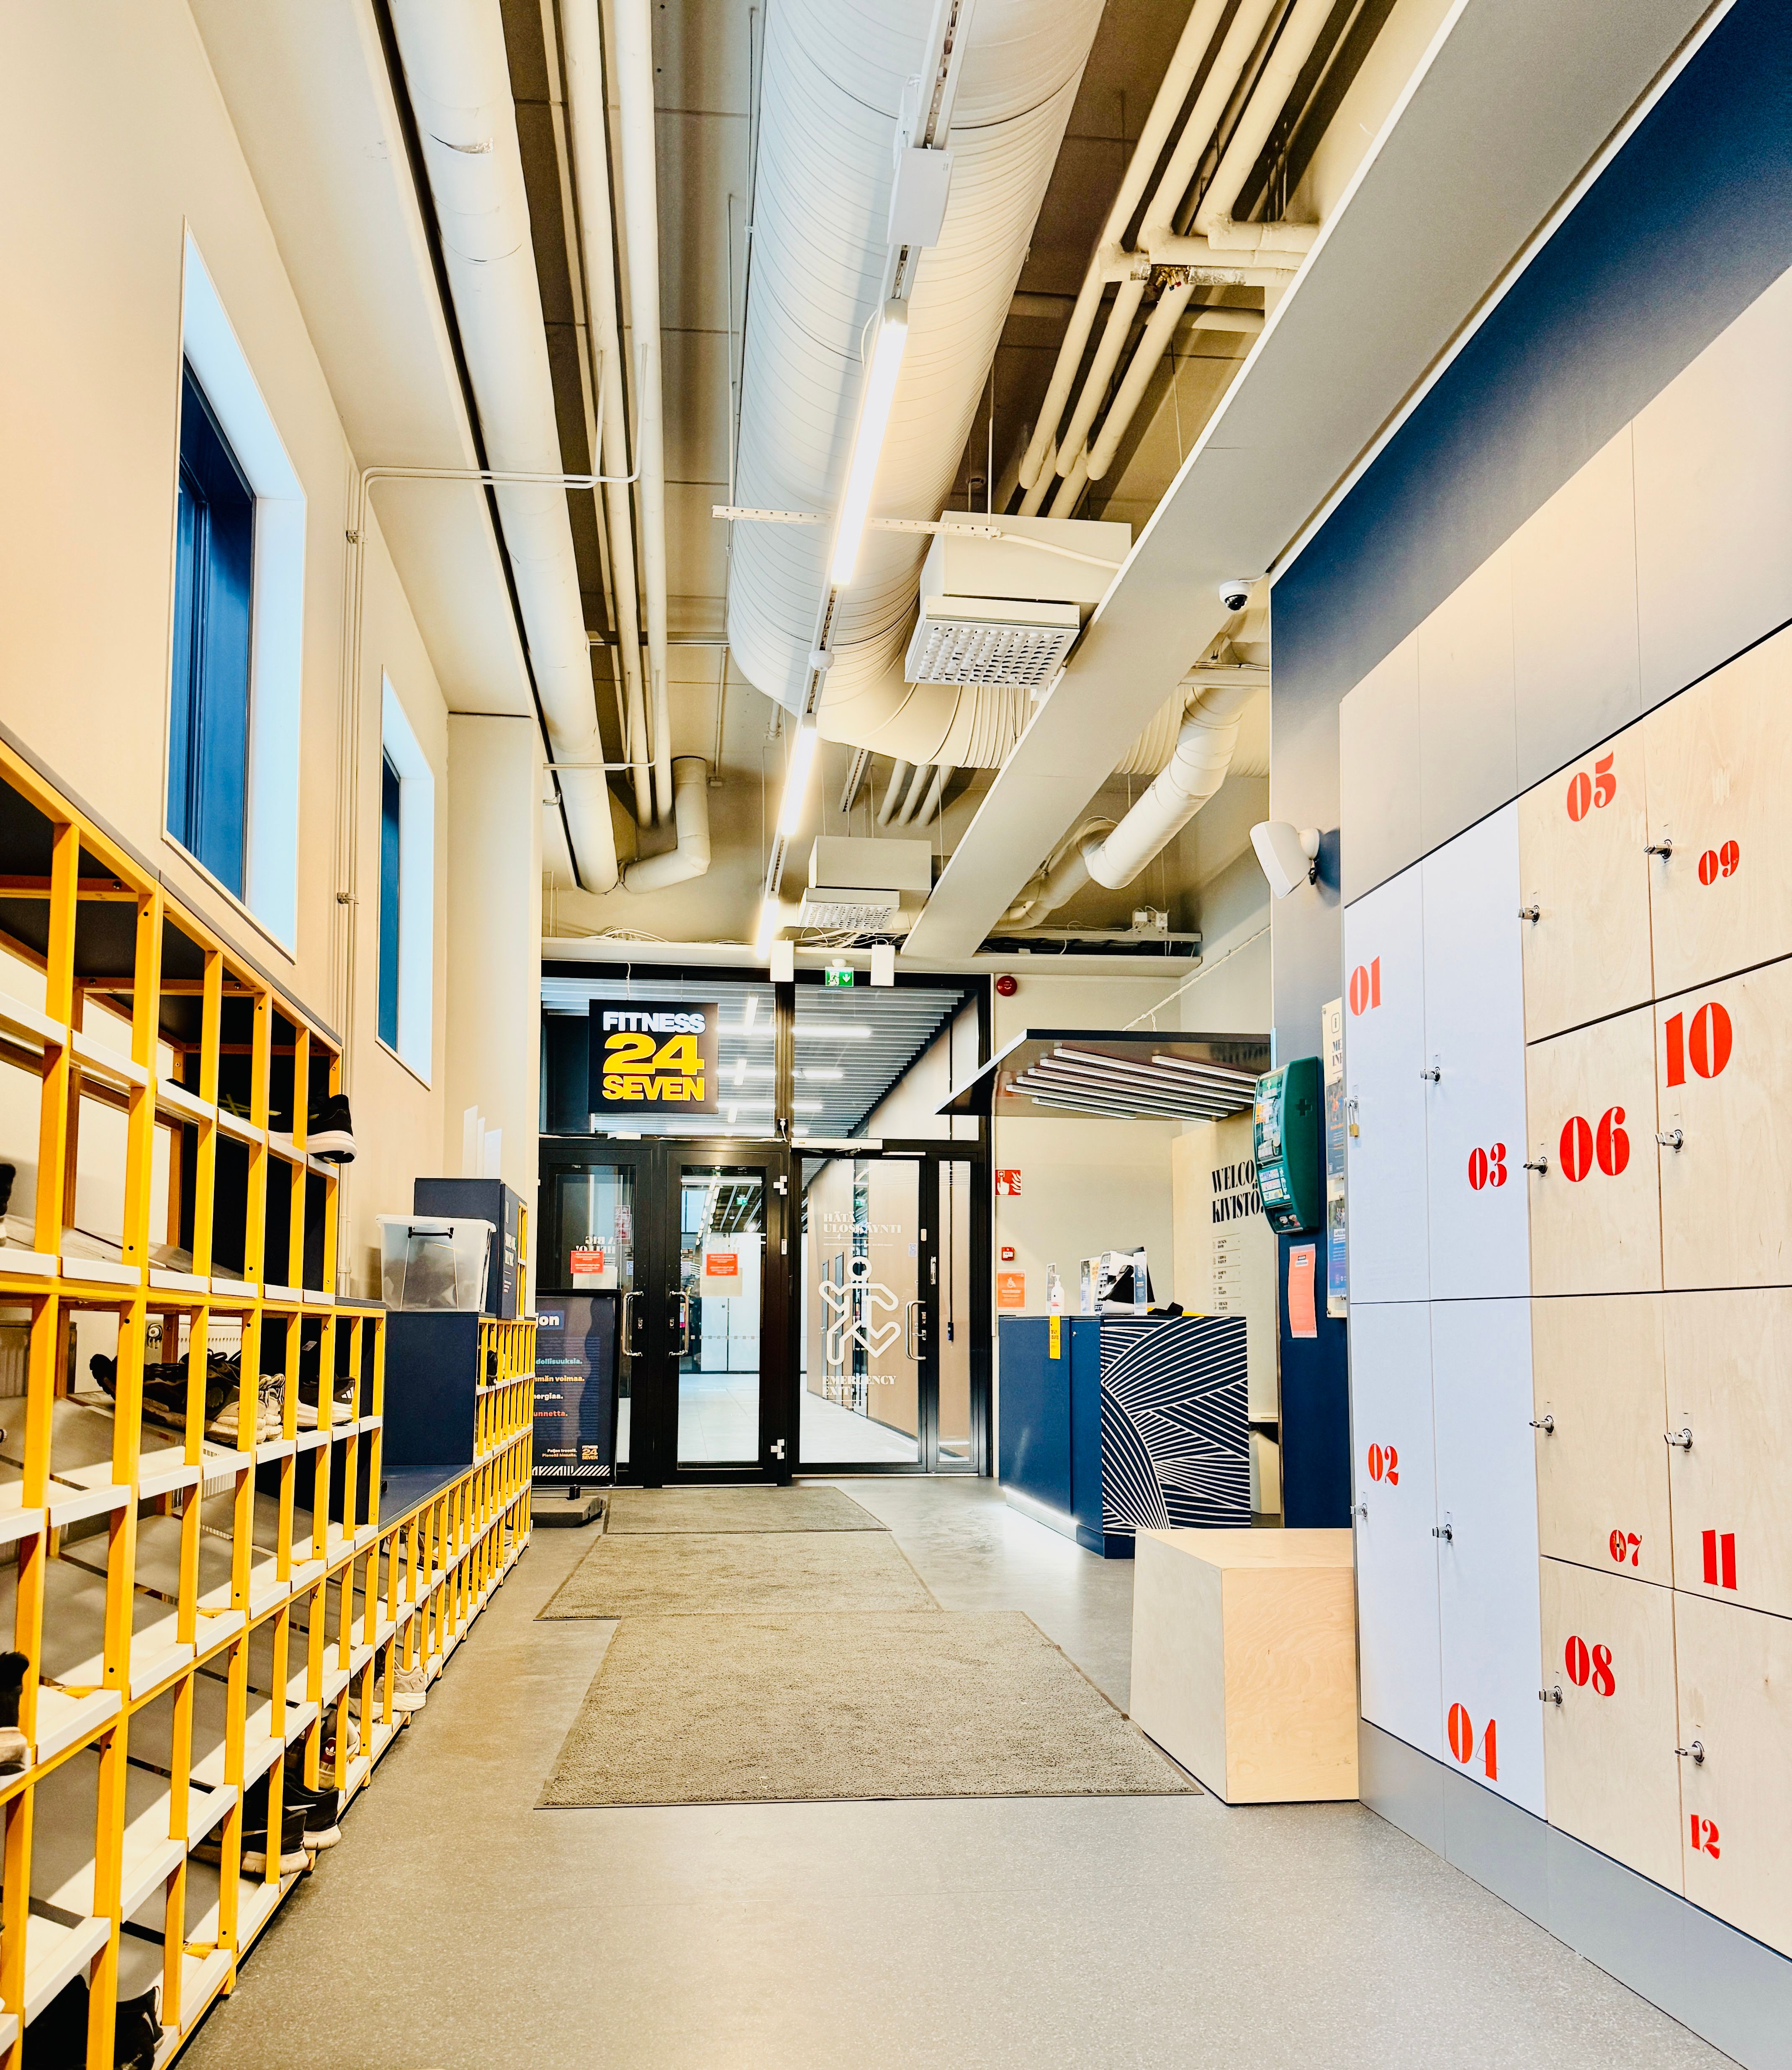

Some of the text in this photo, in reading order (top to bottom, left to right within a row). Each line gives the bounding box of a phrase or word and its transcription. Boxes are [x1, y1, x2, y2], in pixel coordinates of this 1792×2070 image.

[1567, 752, 1616, 822] 05
[1698, 840, 1740, 886] 09
[1350, 957, 1381, 1016] 01
[603, 1011, 706, 1034] FITNESS
[1665, 1002, 1733, 1088] 10
[603, 1032, 705, 1075] 24
[602, 1075, 705, 1101] SEVEN
[1468, 1143, 1507, 1190] 03
[1559, 1106, 1630, 1182] 06
[1212, 1159, 1257, 1193] WELCO
[823, 1222, 901, 1233] ULOSKÄYNTI
[1368, 1443, 1399, 1486] 02
[1609, 1529, 1642, 1567] 07
[1701, 1529, 1737, 1590] 11
[1565, 1635, 1615, 1697] 08
[1447, 1703, 1499, 1782] 04
[1690, 1814, 1720, 1859] 12
